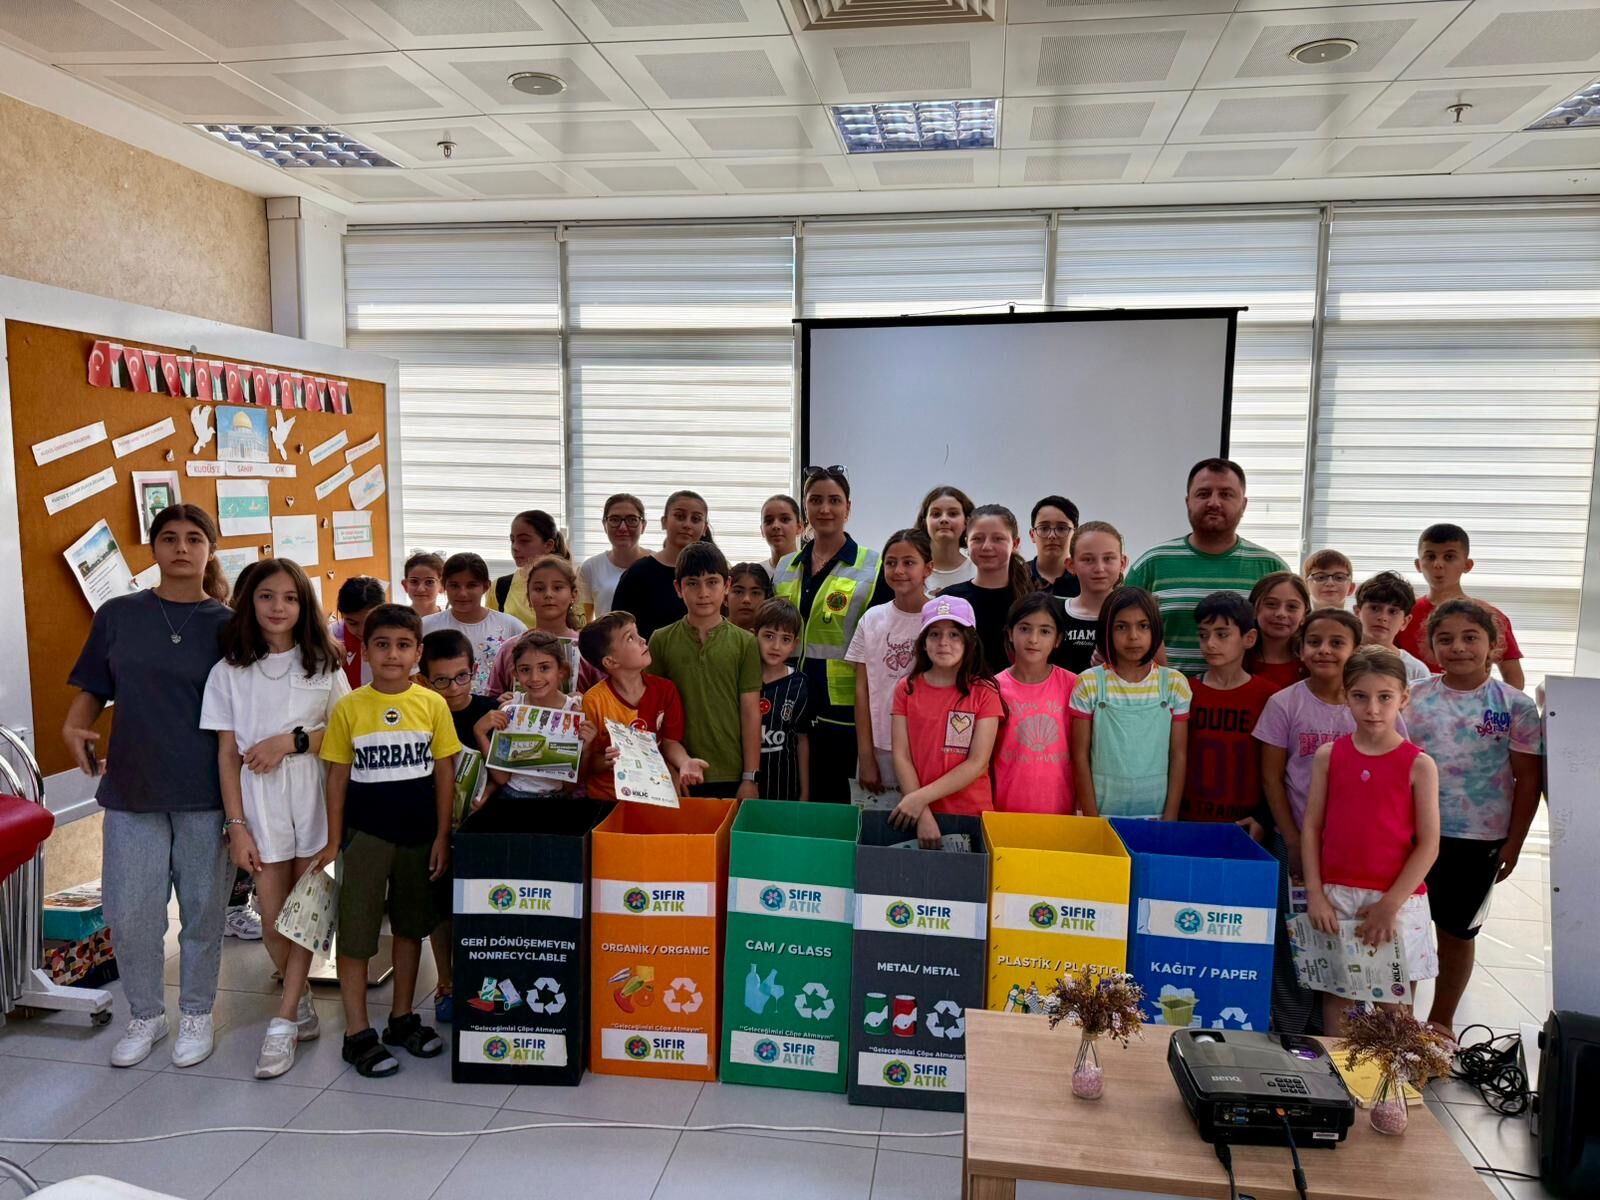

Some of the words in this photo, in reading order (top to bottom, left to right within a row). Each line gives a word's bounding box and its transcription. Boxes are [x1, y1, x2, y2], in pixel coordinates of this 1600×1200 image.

[1064, 629, 1096, 640] MIAM
[1196, 707, 1250, 733] DUDE
[761, 725, 786, 745] ko
[519, 887, 552, 898] SIFIR
[652, 890, 685, 900] SIFIR
[788, 889, 822, 902] SIFIR
[519, 898, 551, 910] ATIK
[653, 901, 684, 912] ATIK
[788, 900, 821, 913] ATIK
[917, 905, 951, 918] SIFIR
[1061, 906, 1096, 919] SIFIR
[1207, 911, 1243, 924] SIFIR
[917, 917, 950, 930] ATIK
[1061, 917, 1095, 931] ATIK
[1207, 924, 1241, 936] ATIK
[461, 936, 487, 947] GERİ
[490, 936, 575, 950] DÖNÜŞEMEYEN
[601, 943, 649, 954] ORGANİK
[652, 945, 659, 955] /
[660, 945, 710, 955] ORGANIC
[745, 939, 775, 953] CAM
[778, 943, 785, 954] /
[788, 944, 832, 958] GLASS
[469, 951, 567, 962] NONRECYCLABLE
[997, 955, 1051, 970] PLASTİK
[1055, 961, 1061, 971] /
[923, 966, 960, 977] METAL
[1151, 962, 1196, 976] KAĞIT
[1199, 966, 1207, 978] /
[1211, 968, 1257, 980] PAPER
[513, 1038, 545, 1049] SIFIR
[653, 1038, 685, 1049] SIFIR
[783, 1042, 815, 1055] SIFIR
[513, 1049, 544, 1061] ATIK
[653, 1049, 685, 1060] ATIK
[783, 1053, 814, 1066] ATIK
[914, 1064, 947, 1076] SIFIR
[914, 1075, 947, 1087] ATIK
